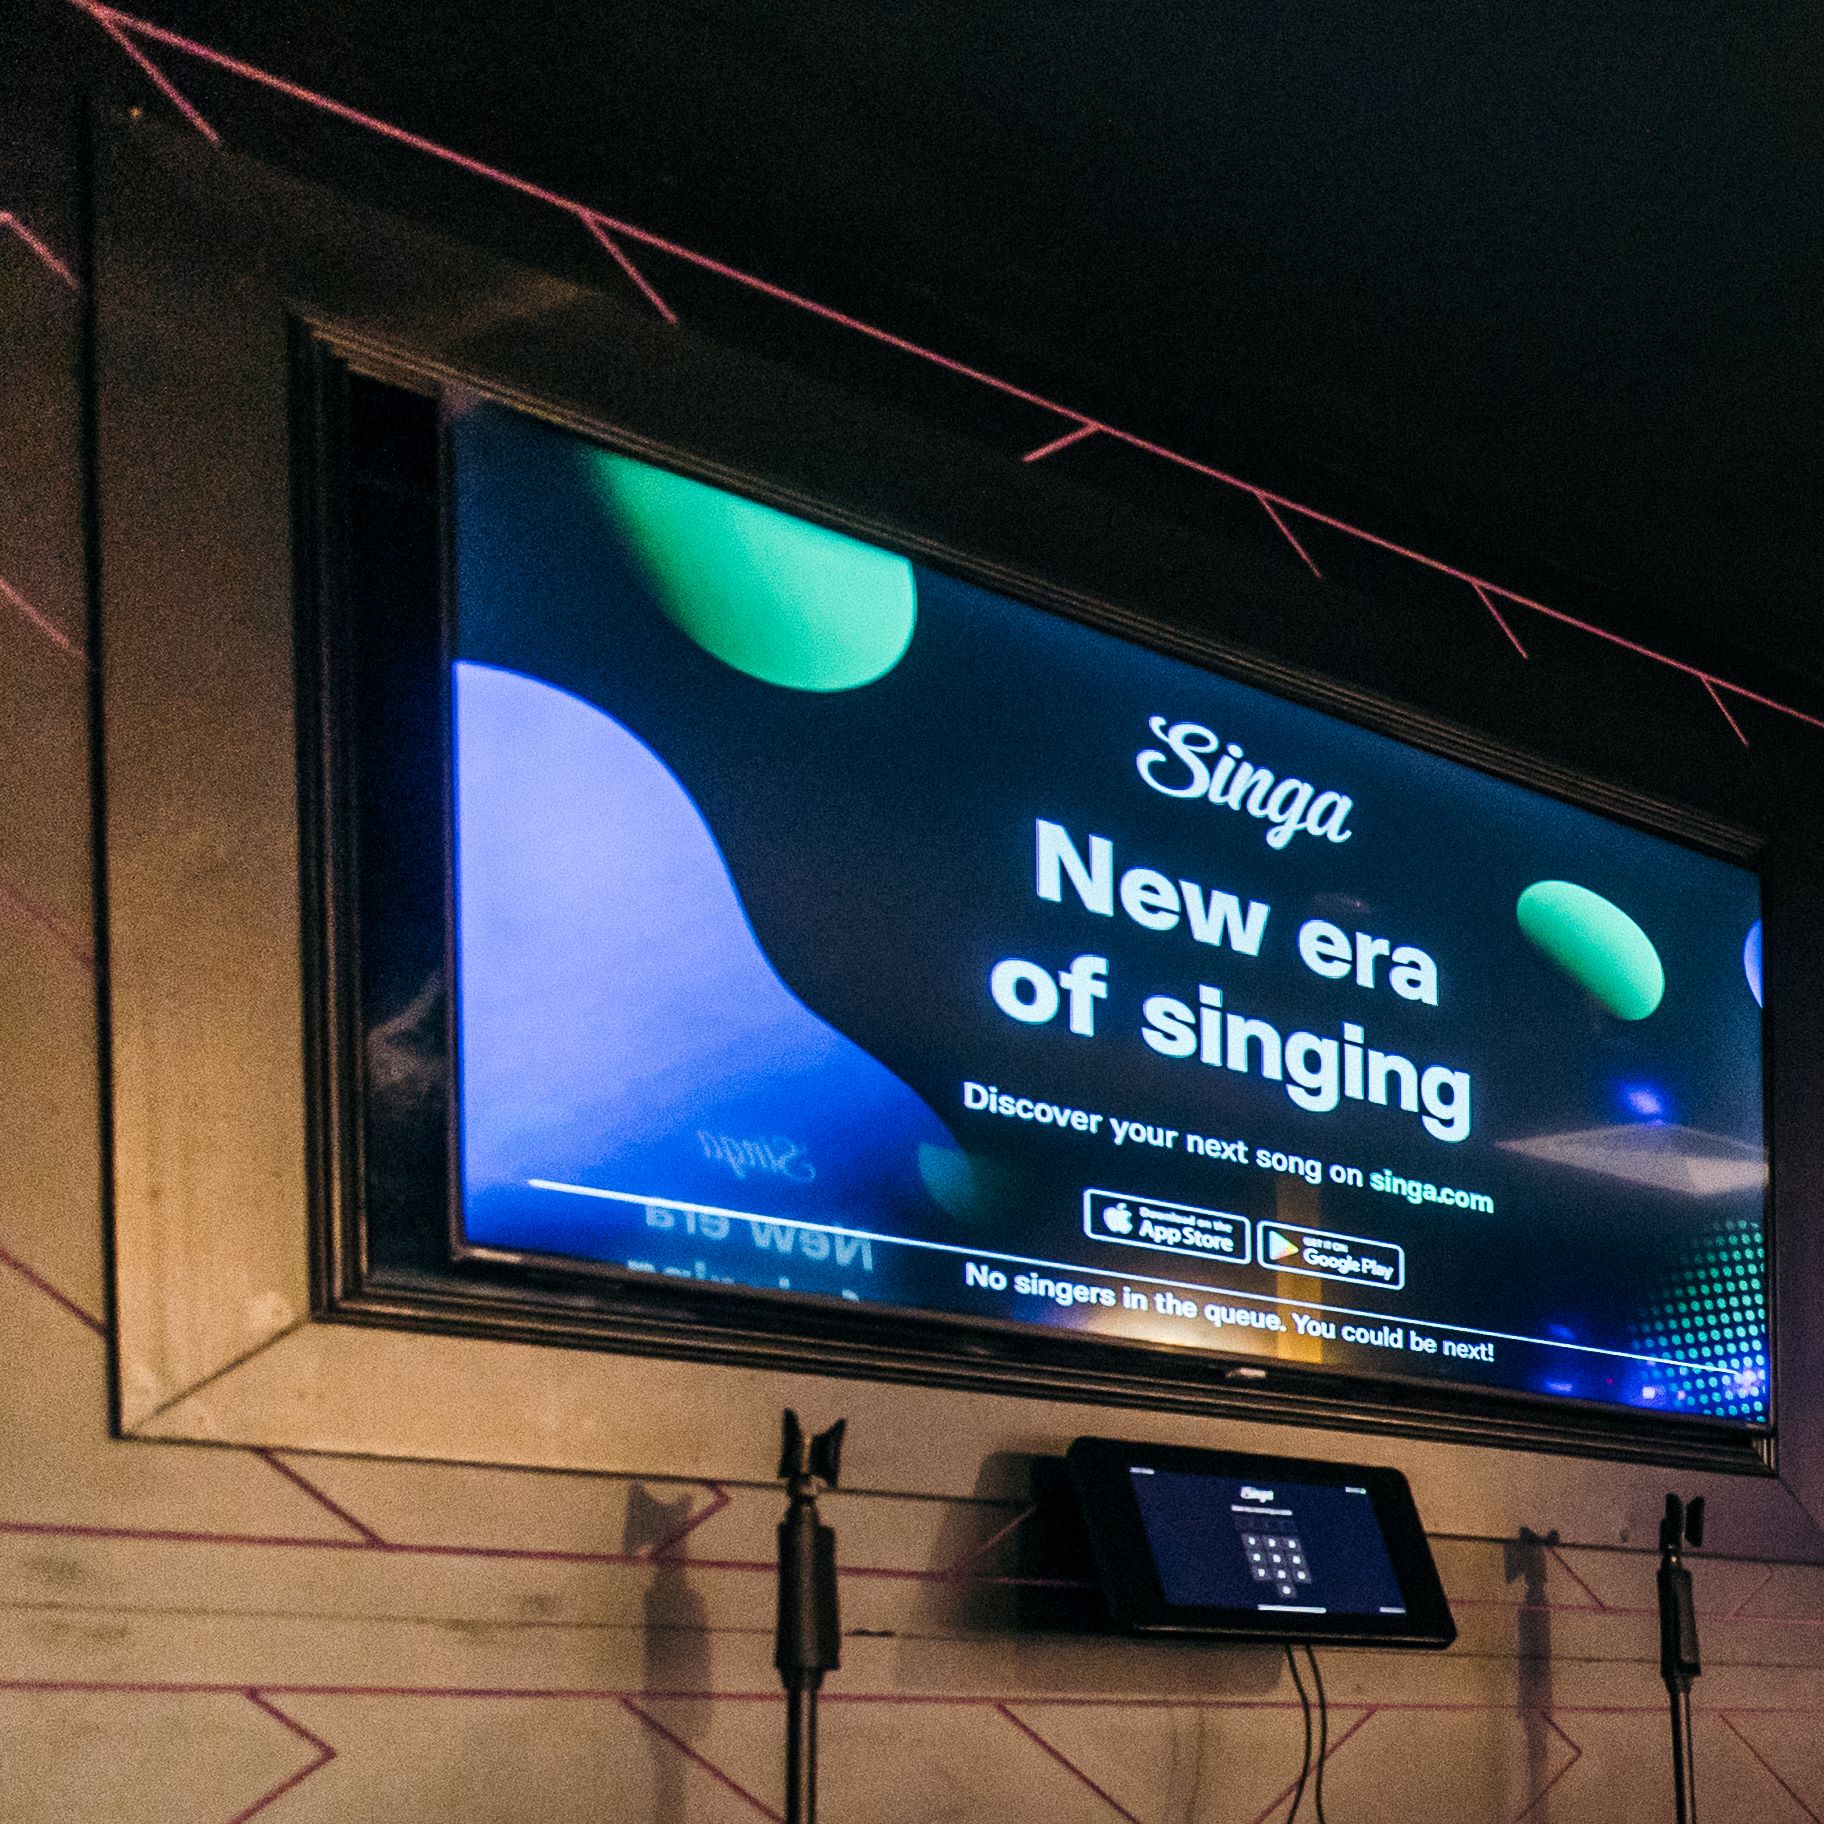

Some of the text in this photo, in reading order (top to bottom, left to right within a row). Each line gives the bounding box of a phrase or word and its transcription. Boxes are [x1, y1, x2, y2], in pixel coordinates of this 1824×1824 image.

[1136, 715, 1354, 850] Singa
[1035, 817, 1440, 1007] New era
[990, 954, 1471, 1144] of singing
[963, 1081, 1494, 1214] Discover your next song on singa.com
[1138, 1219, 1234, 1253] App Store
[1302, 1248, 1394, 1282] Google Play
[965, 1262, 1495, 1363] No singers in the queue. You could be next!
